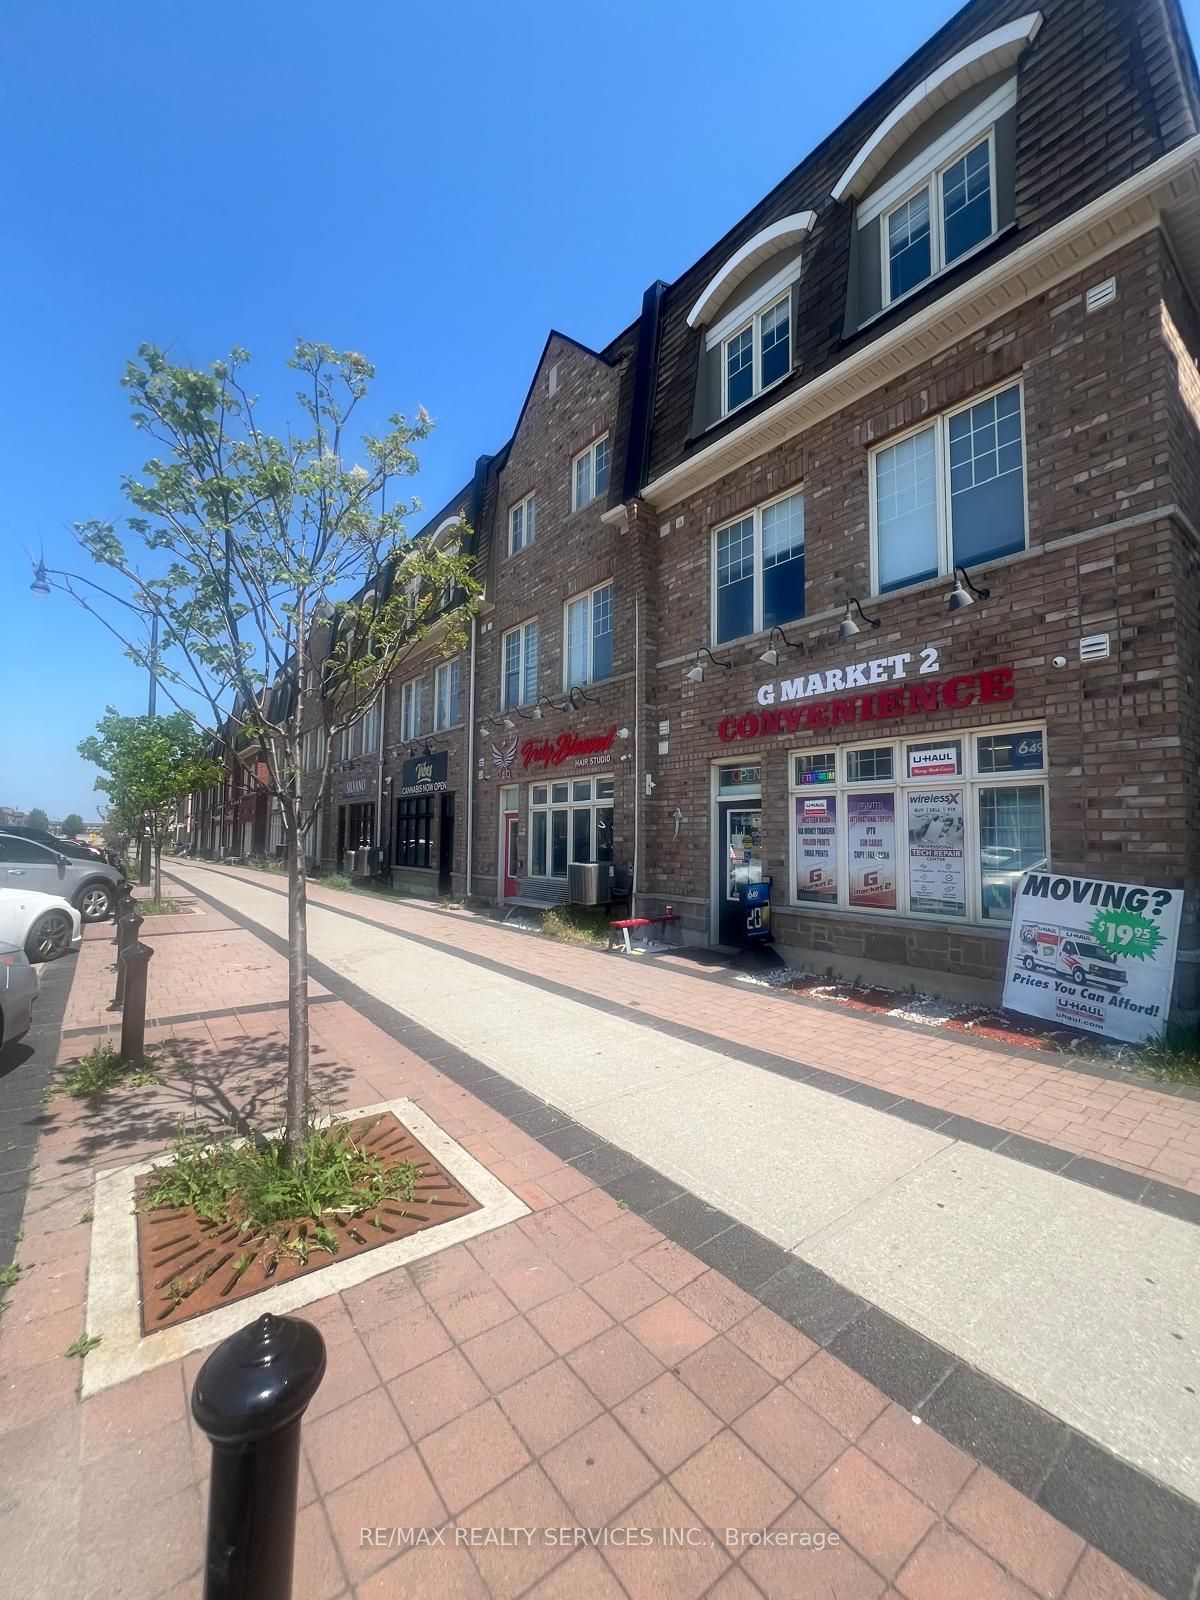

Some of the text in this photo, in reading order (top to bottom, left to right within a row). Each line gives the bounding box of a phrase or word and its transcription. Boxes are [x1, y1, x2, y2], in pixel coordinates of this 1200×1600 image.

[757, 648, 940, 706] G MARKET 2
[718, 667, 1015, 743] CONVENIENCE
[574, 755, 611, 767] HAIR STUDIO
[913, 753, 953, 763] U-HAUL
[732, 767, 761, 782] OPEN
[401, 781, 447, 795] CANNABIS NOW OPEN
[1022, 874, 1173, 916] MOVING?
[1012, 972, 1049, 989] Prices
[1054, 981, 1076, 996] You
[1080, 988, 1105, 1003] Can
[1108, 995, 1160, 1018] Afford!
[1058, 998, 1104, 1017] U-HAUL
[1055, 1012, 1104, 1030] uhaul.com
